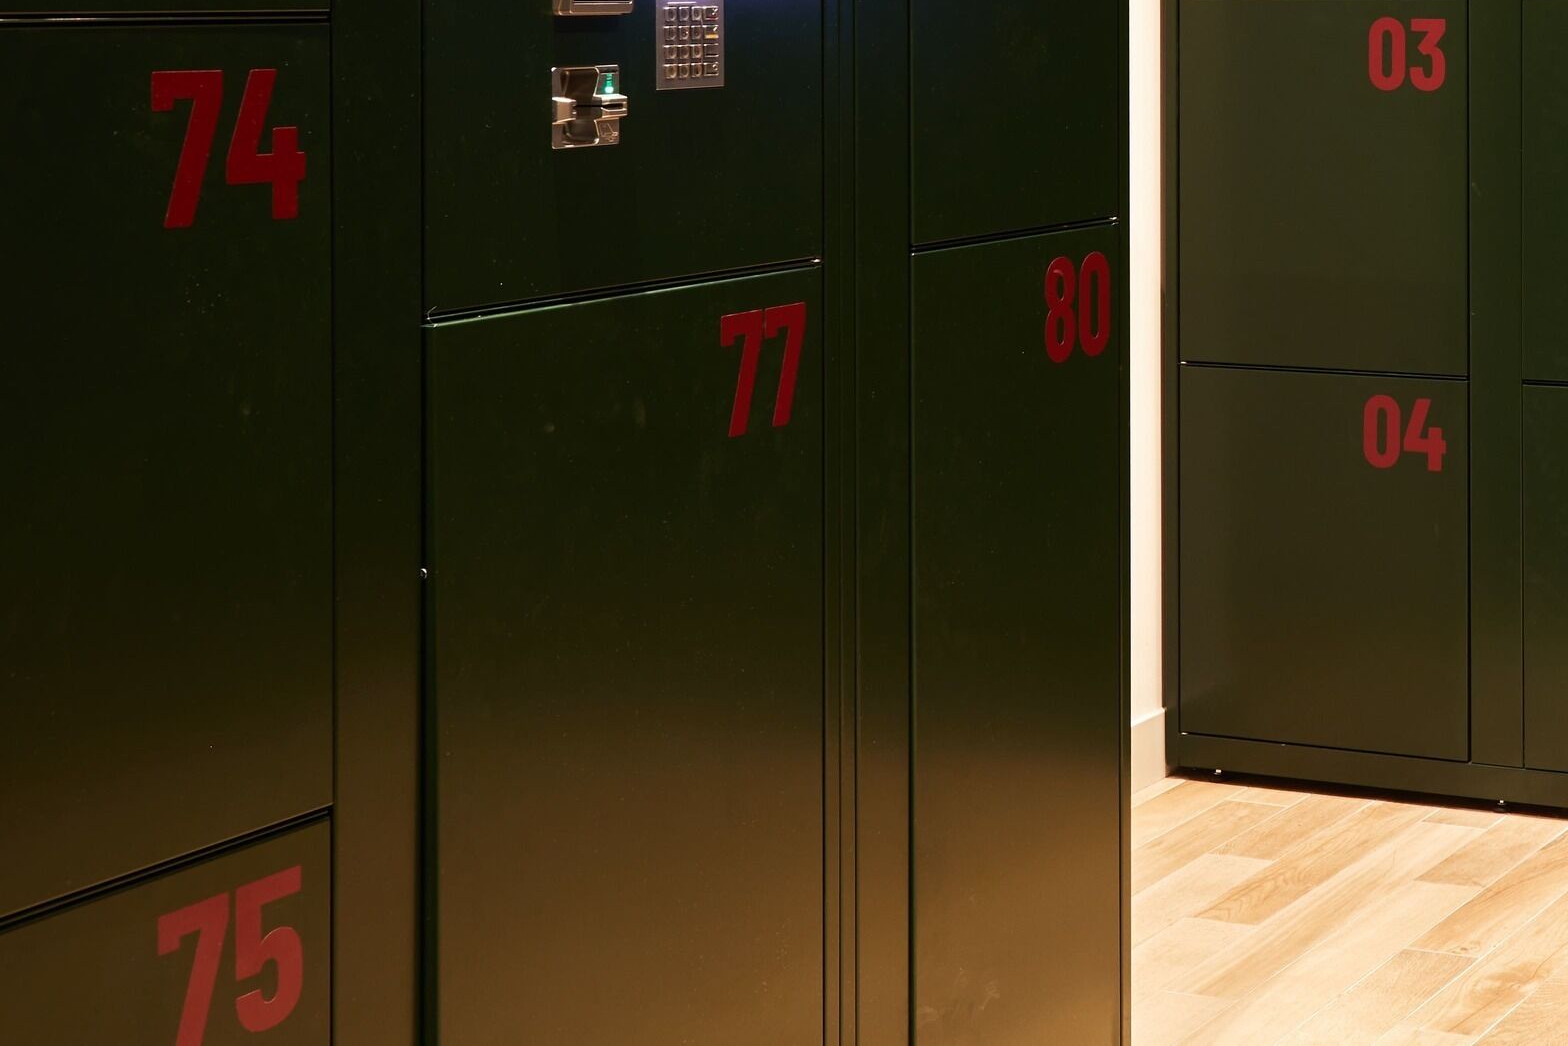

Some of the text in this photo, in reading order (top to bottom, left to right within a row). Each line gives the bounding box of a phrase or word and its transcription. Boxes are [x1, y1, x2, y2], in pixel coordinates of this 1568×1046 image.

[1369, 17, 1446, 91] 03
[153, 70, 306, 229] 74
[1046, 253, 1110, 362] 80
[722, 303, 806, 437] 77
[1364, 396, 1447, 472] 04
[159, 866, 304, 1046] 75
